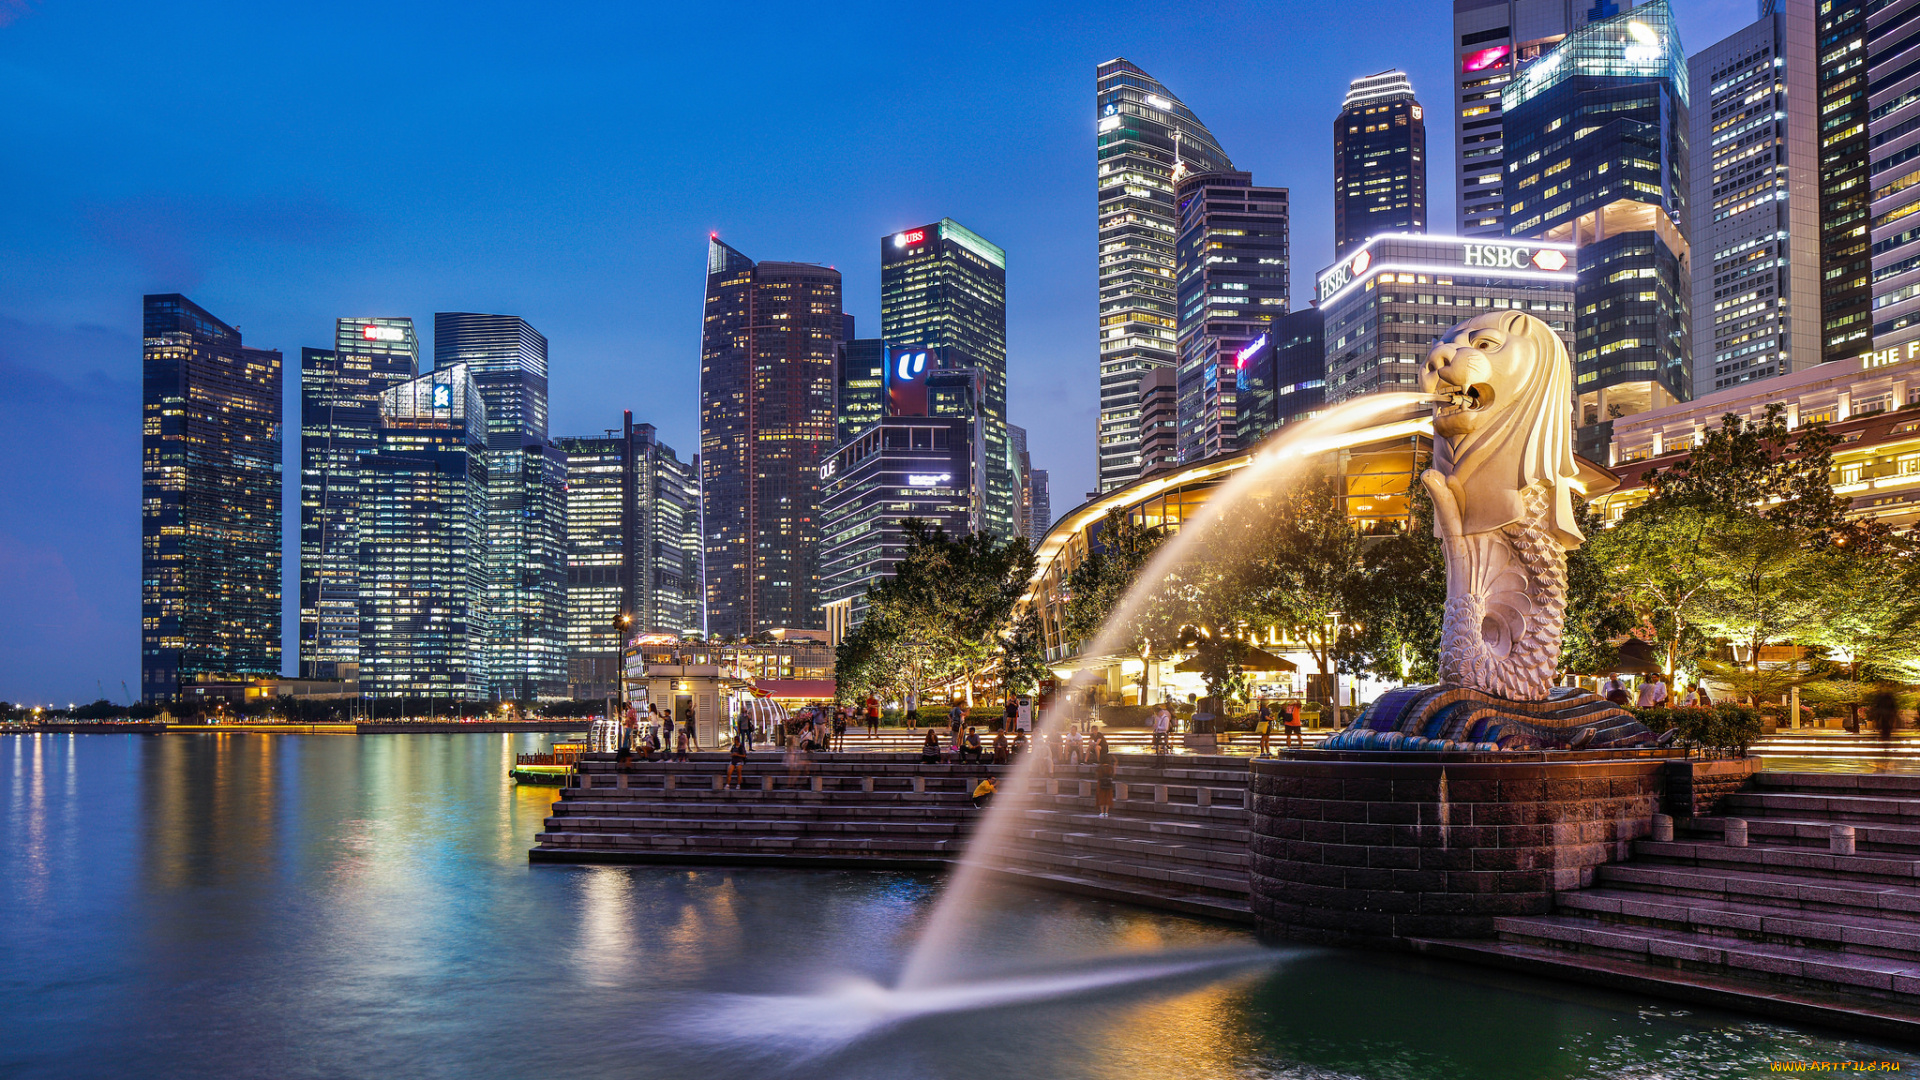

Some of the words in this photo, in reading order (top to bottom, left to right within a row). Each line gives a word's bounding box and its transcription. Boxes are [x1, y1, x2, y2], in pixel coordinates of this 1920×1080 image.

[905, 231, 923, 243] UBS
[1463, 244, 1530, 269] HSBC
[1320, 261, 1352, 302] HSBC
[1859, 347, 1900, 369] THE
[820, 460, 836, 480] OUE
